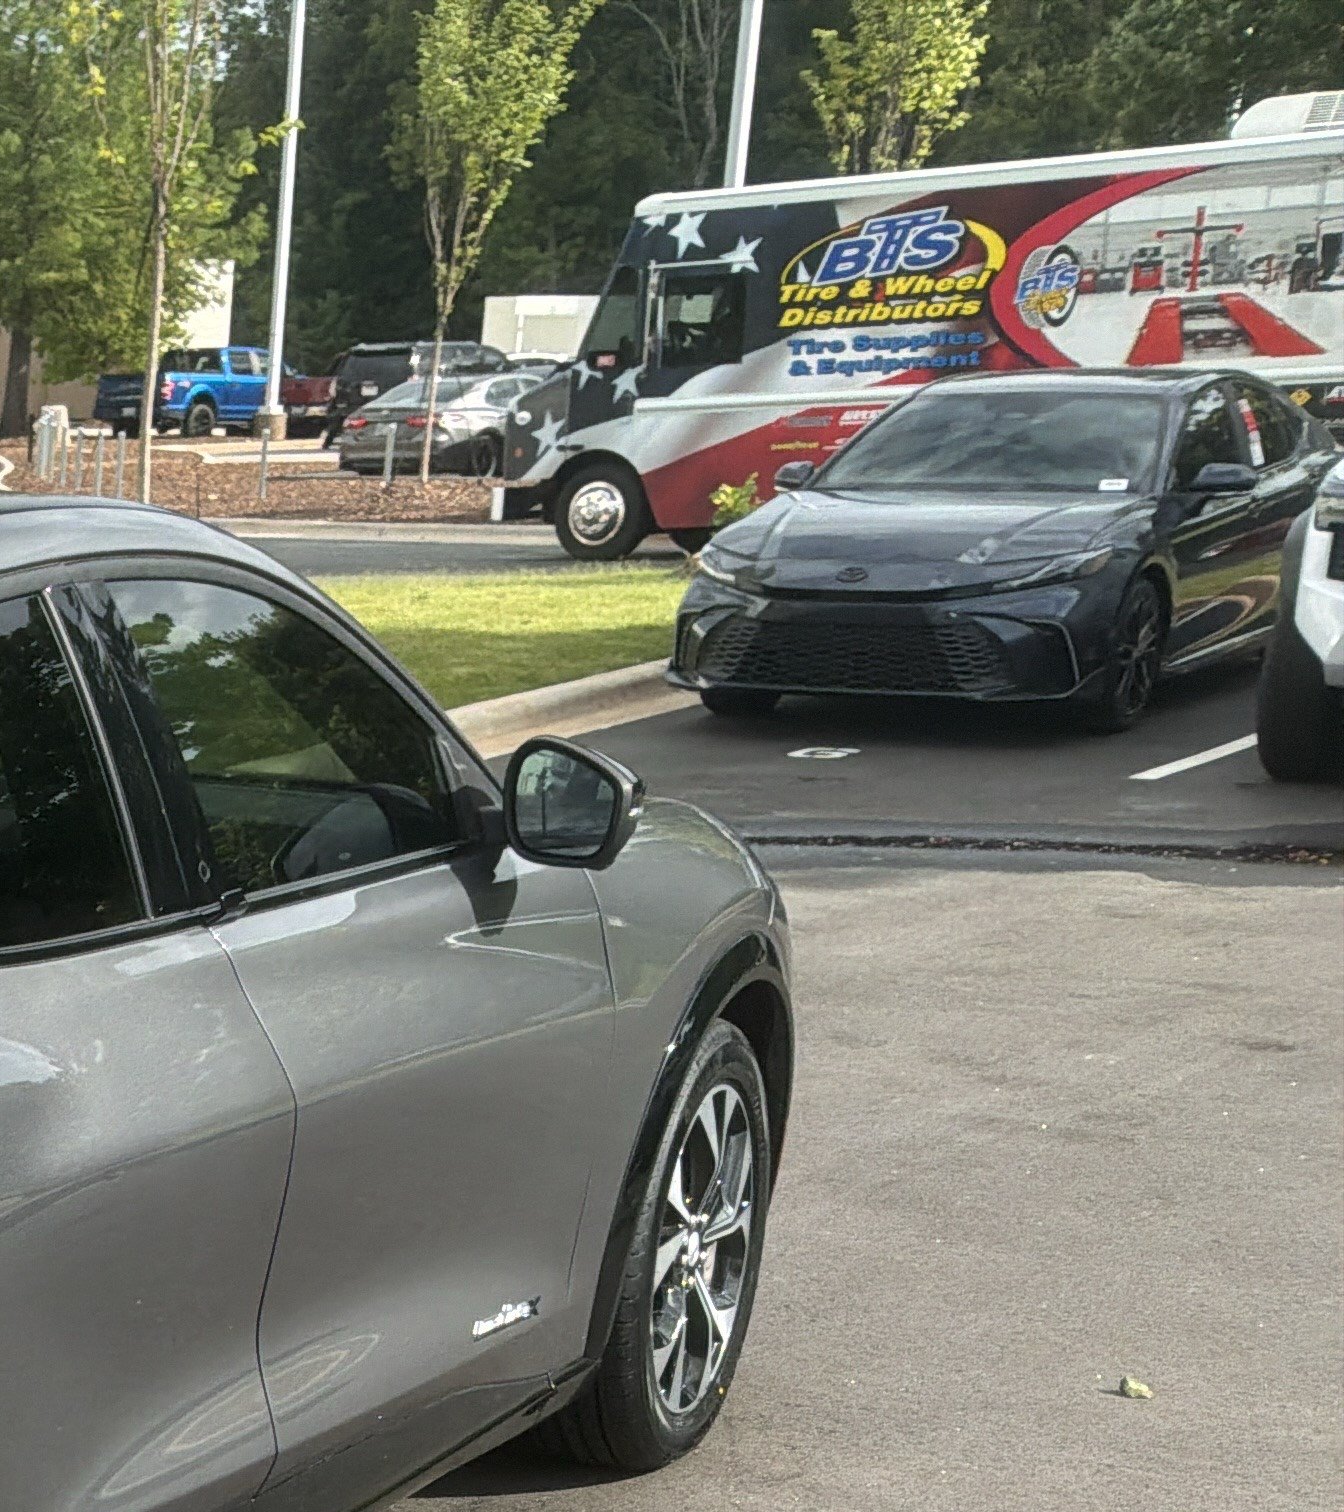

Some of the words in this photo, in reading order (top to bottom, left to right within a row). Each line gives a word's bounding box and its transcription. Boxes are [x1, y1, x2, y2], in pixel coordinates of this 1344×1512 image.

[813, 206, 965, 285] BTS
[779, 283, 840, 303] Tire
[848, 279, 872, 298] &
[885, 270, 992, 296] Wheel
[778, 300, 983, 327] Distributors
[788, 338, 846, 355] Tire
[851, 331, 985, 353] Supplies
[788, 360, 812, 376] &
[816, 351, 980, 377] Equipment
